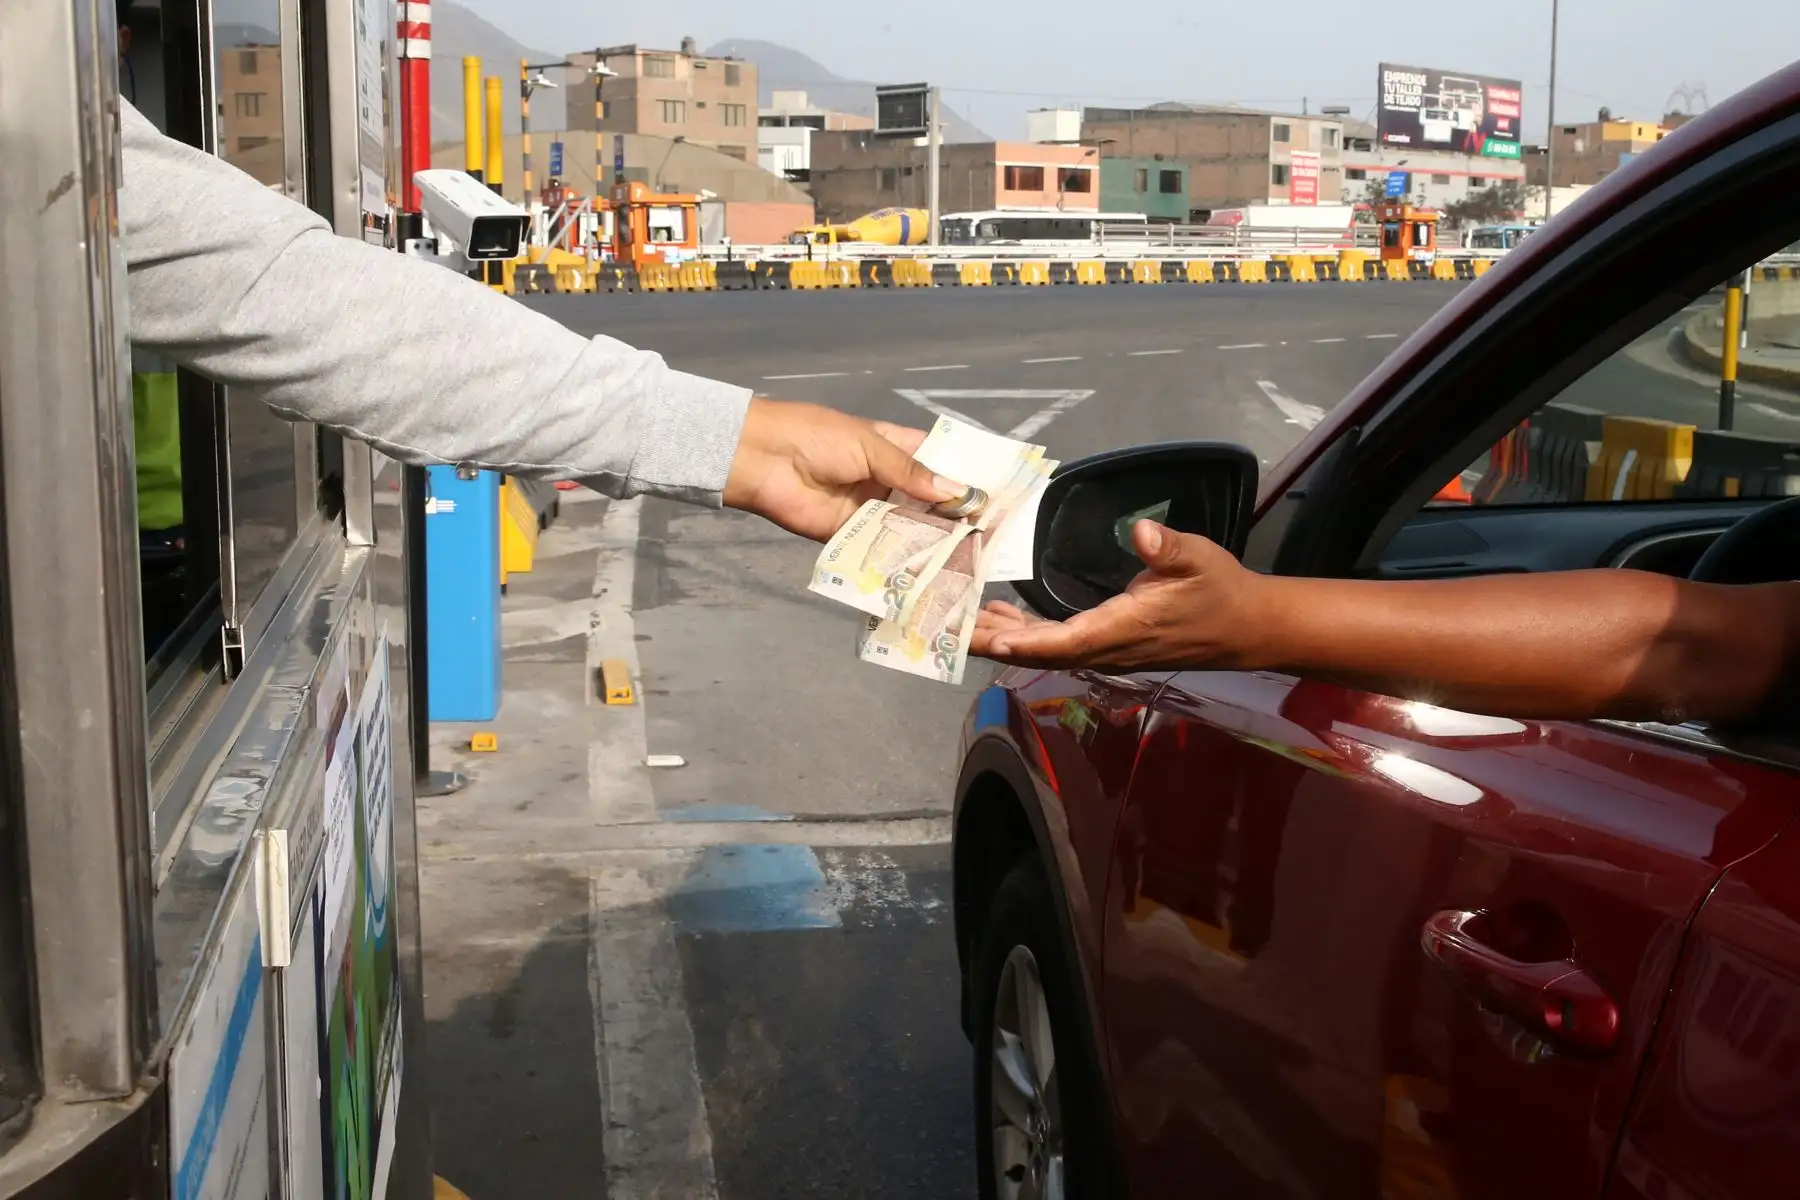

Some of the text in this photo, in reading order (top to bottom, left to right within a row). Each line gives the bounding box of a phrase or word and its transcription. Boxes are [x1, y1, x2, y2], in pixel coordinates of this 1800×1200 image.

[1384, 82, 1422, 96] TU TALLER
[1384, 93, 1395, 104] DE
[883, 572, 915, 612] 20
[933, 632, 960, 674] 20
